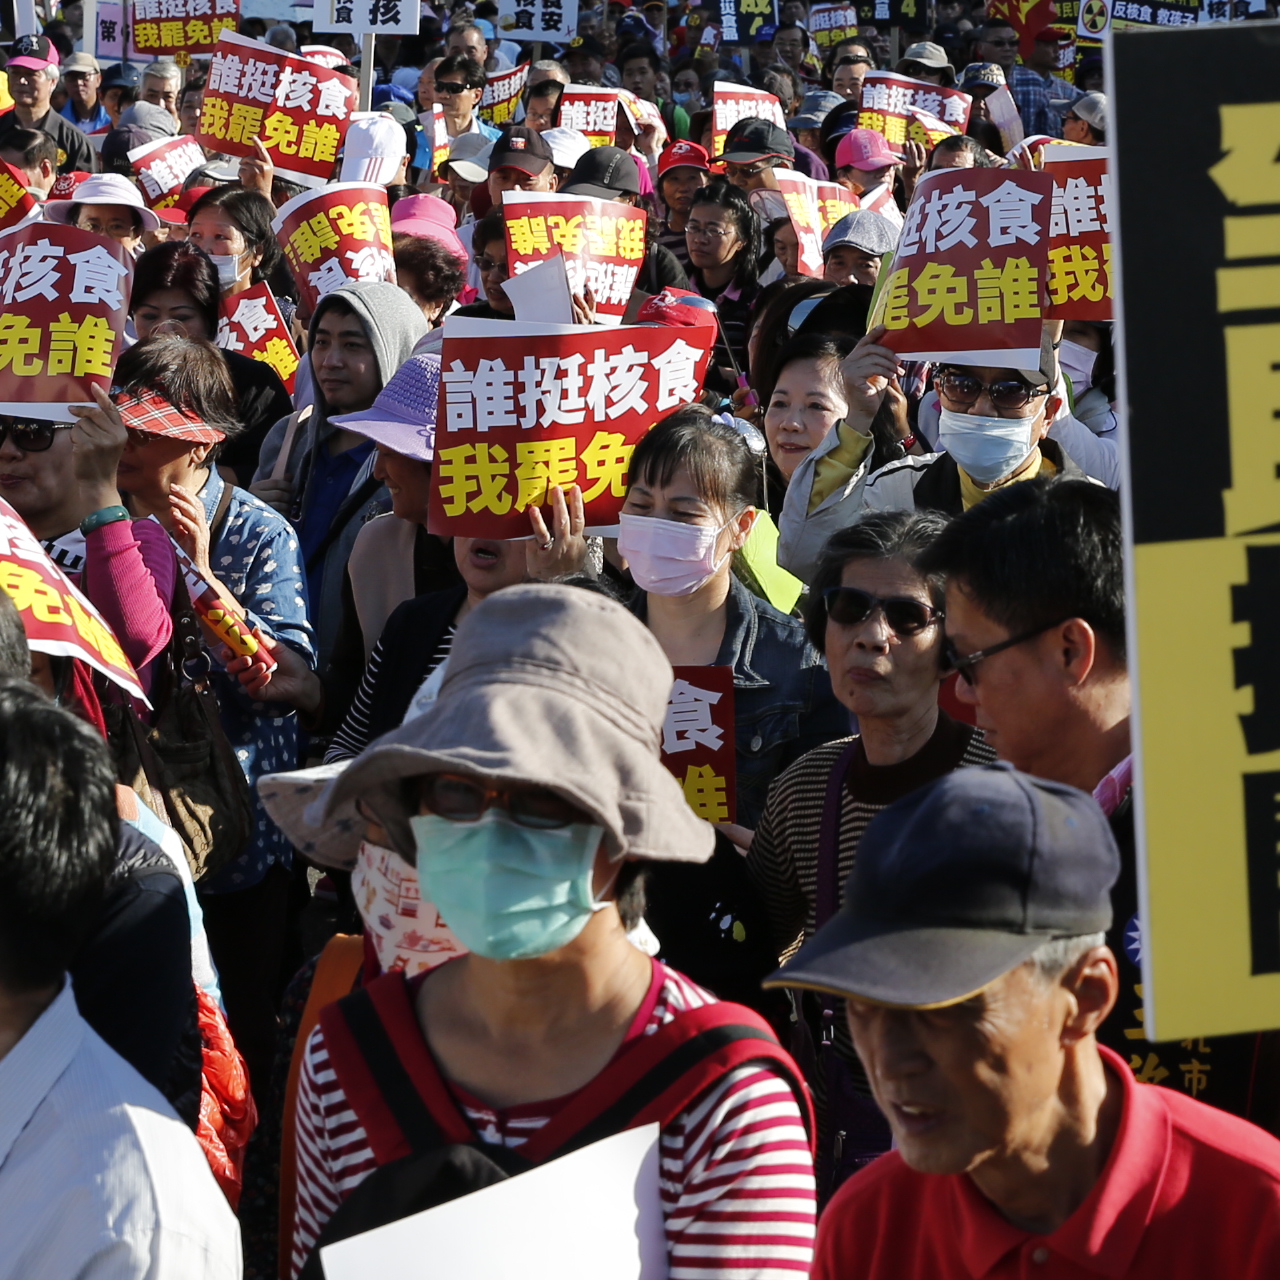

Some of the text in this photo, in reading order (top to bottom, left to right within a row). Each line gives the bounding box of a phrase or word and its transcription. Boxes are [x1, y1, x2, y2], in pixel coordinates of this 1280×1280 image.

[1112, 1, 1196, 27] 反核食 救孩子
[209, 51, 353, 122] 誰挺核食
[862, 83, 968, 124] 誰挺核食
[200, 95, 342, 164] 我罷免誰
[1047, 245, 1117, 306] 我
[441, 337, 705, 434] 誰挺核食
[437, 423, 658, 518] 我罷免
